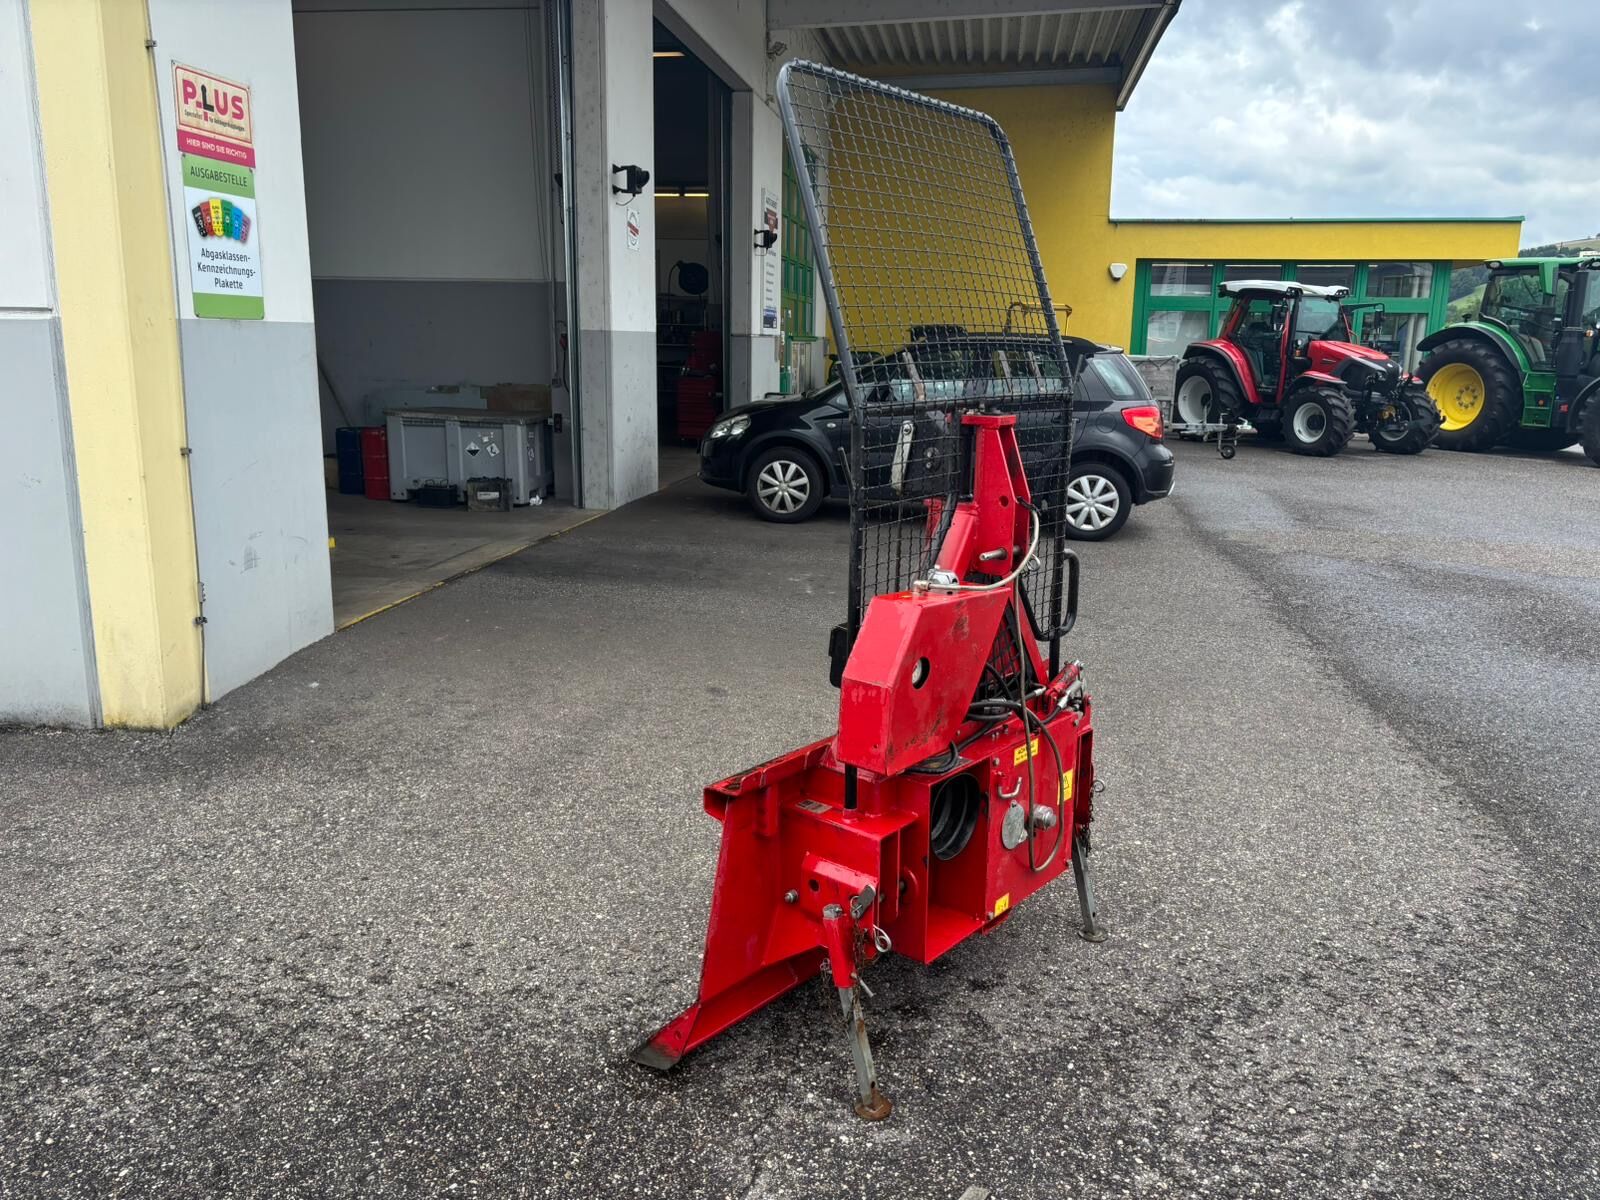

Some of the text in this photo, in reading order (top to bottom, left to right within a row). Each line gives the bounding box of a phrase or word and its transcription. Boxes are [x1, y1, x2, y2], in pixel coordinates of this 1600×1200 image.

[182, 79, 244, 120] PLUS
[186, 137, 247, 160] HIER SIND SIE RICHTIG
[190, 166, 247, 187] AUSGABESTELLE
[201, 248, 250, 263] Abgasklassen-
[197, 262, 256, 278] Kennzeichnungs-
[214, 278, 243, 290] Plakette
